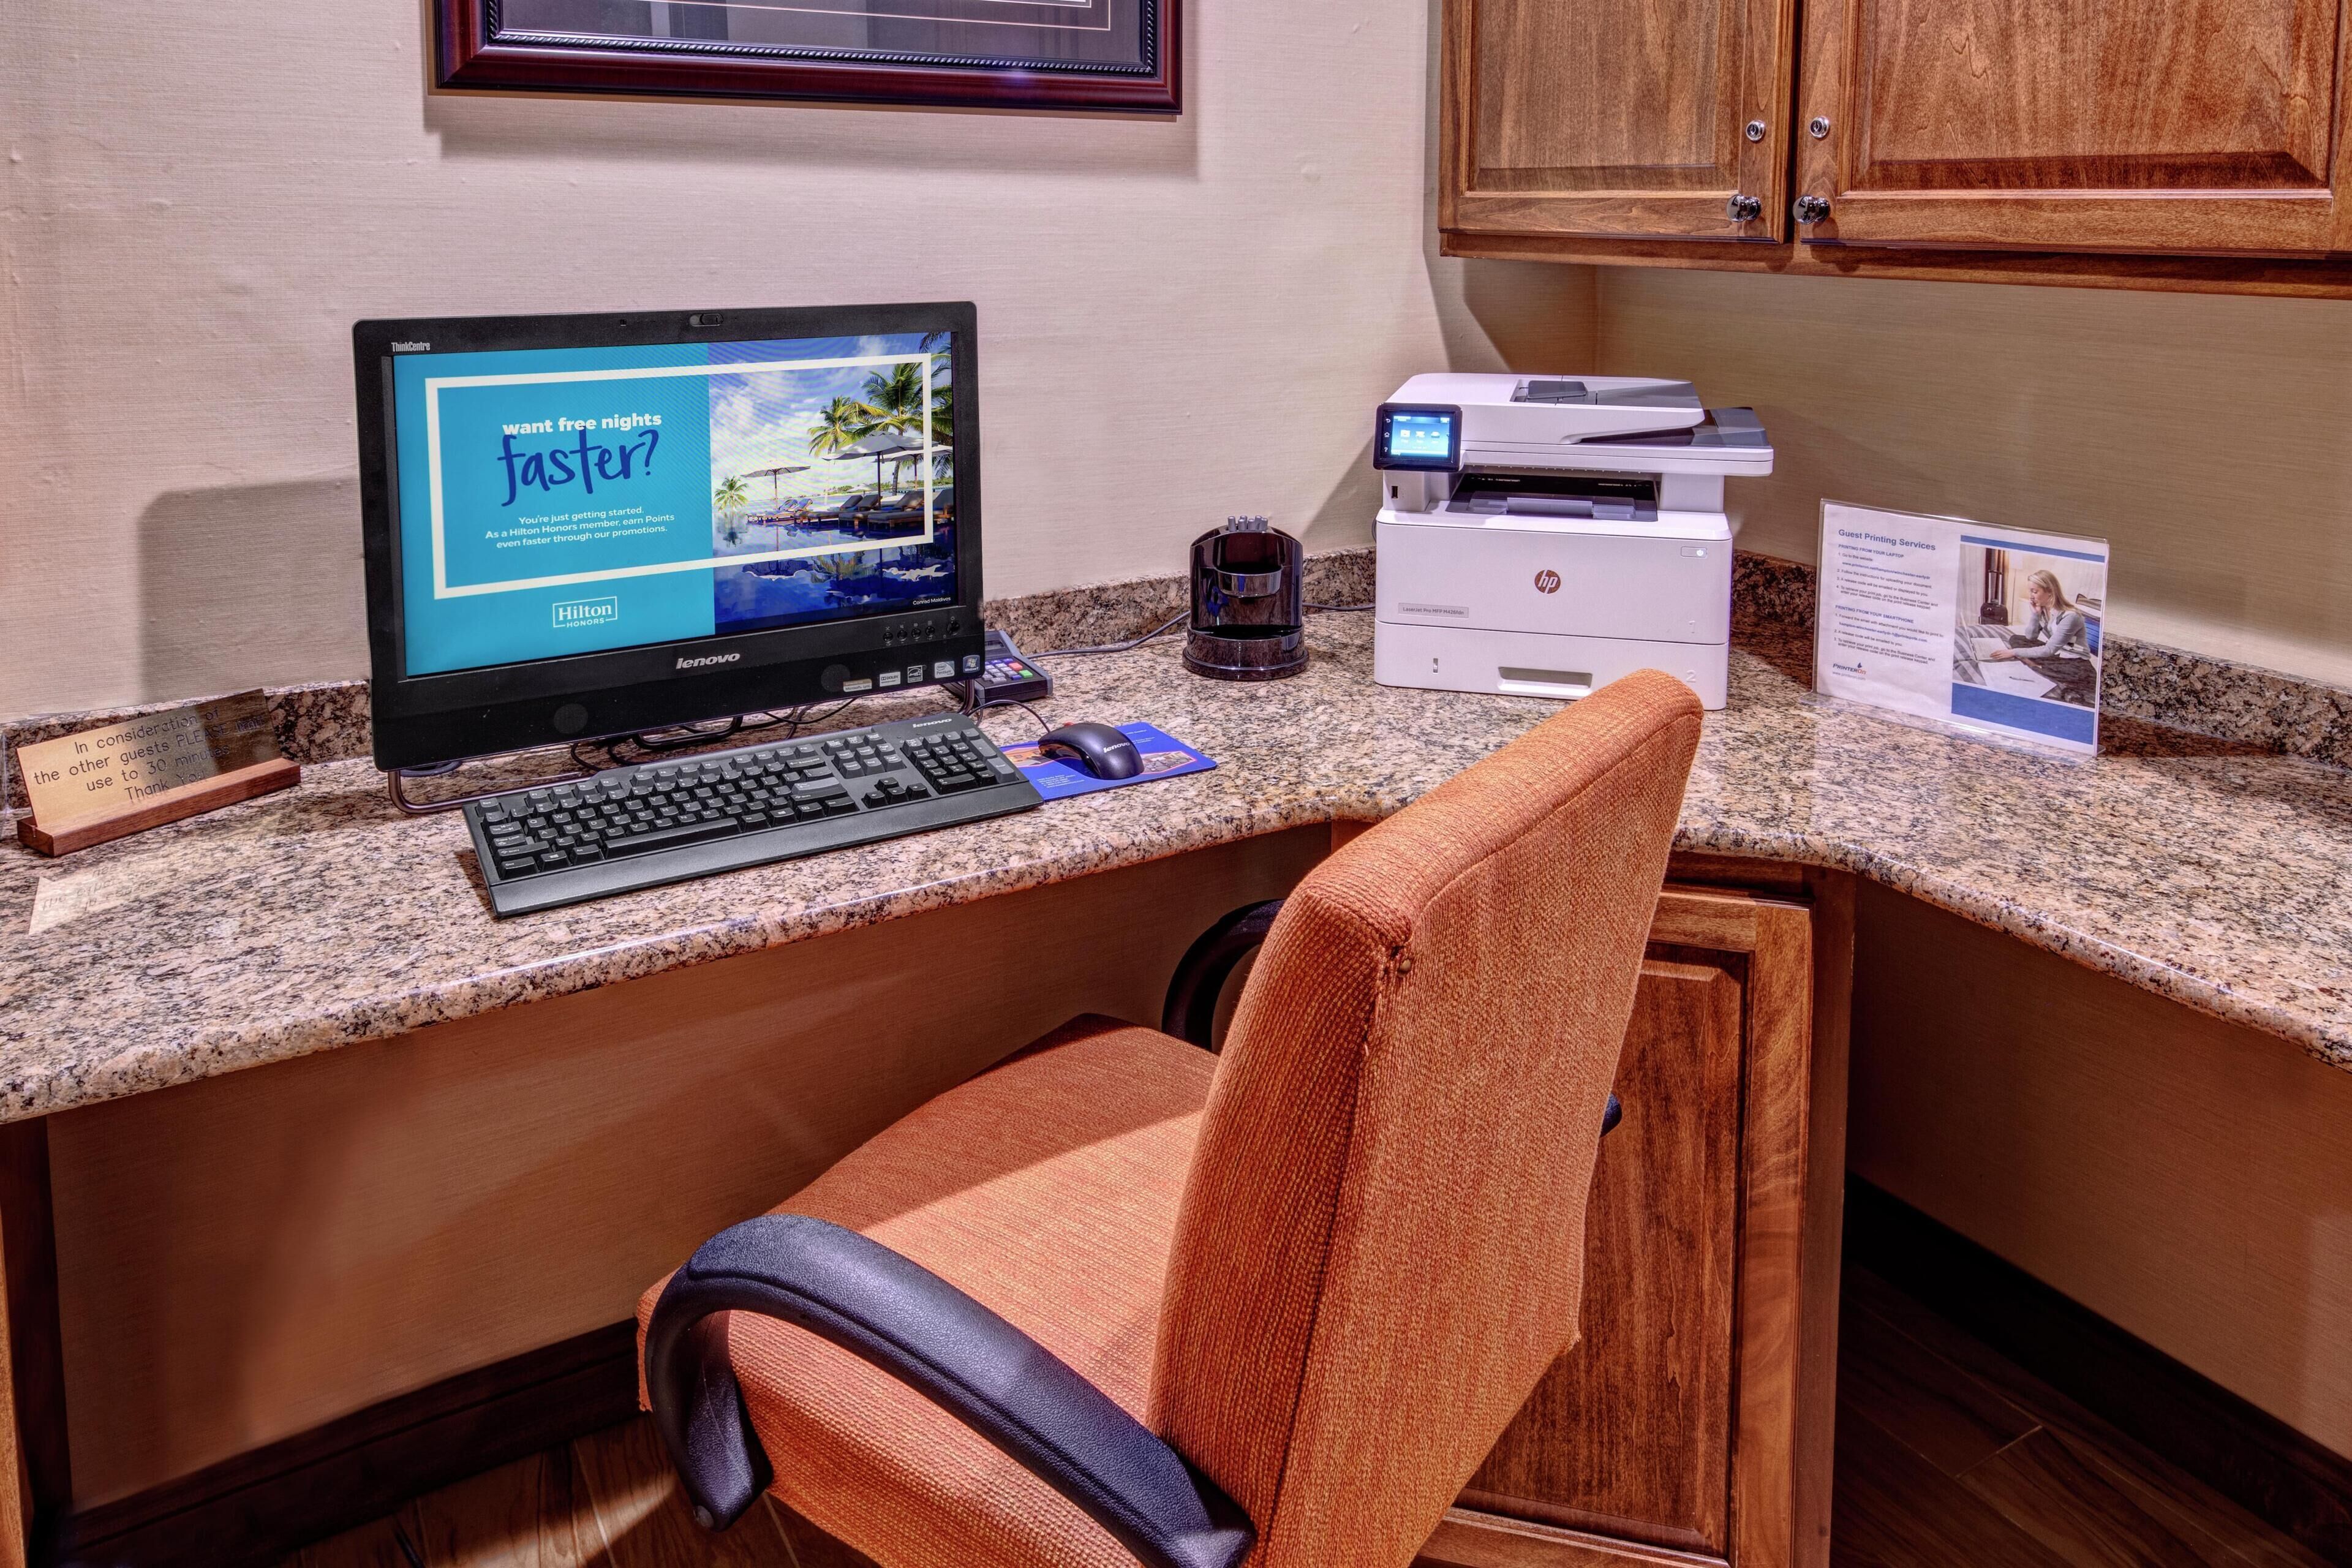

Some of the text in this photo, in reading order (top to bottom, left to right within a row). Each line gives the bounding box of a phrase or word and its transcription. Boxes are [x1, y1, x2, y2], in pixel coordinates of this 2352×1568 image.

[391, 341, 430, 352] ThinkCentre
[502, 413, 662, 435] want free nights
[497, 426, 659, 507] faster?
[519, 506, 644, 525] You're just getting started.
[485, 530, 499, 539] As
[510, 526, 540, 536] Hilton
[542, 523, 578, 533] Honors
[579, 519, 620, 530] member,
[646, 514, 674, 523] Points
[522, 536, 551, 546] faster
[553, 532, 592, 543] through
[612, 526, 668, 538] promotions.
[1839, 529, 1936, 551] Guest Printing Services
[1536, 569, 1559, 594] hp
[559, 605, 612, 620] Hilton
[567, 617, 605, 628] HONORS
[1883, 614, 1914, 624] SMARTPHONE
[676, 653, 741, 669] lenovo
[1686, 670, 1696, 683] 2
[75, 707, 219, 755] In consideration of
[913, 718, 952, 728] lenovo
[34, 767, 60, 785] the
[69, 756, 110, 776] other
[121, 742, 170, 766] guests
[177, 722, 231, 748] PLEASE
[1103, 742, 1130, 753] lenovo
[86, 744, 230, 791] use to 30 minutes
[124, 778, 170, 800] Thank
